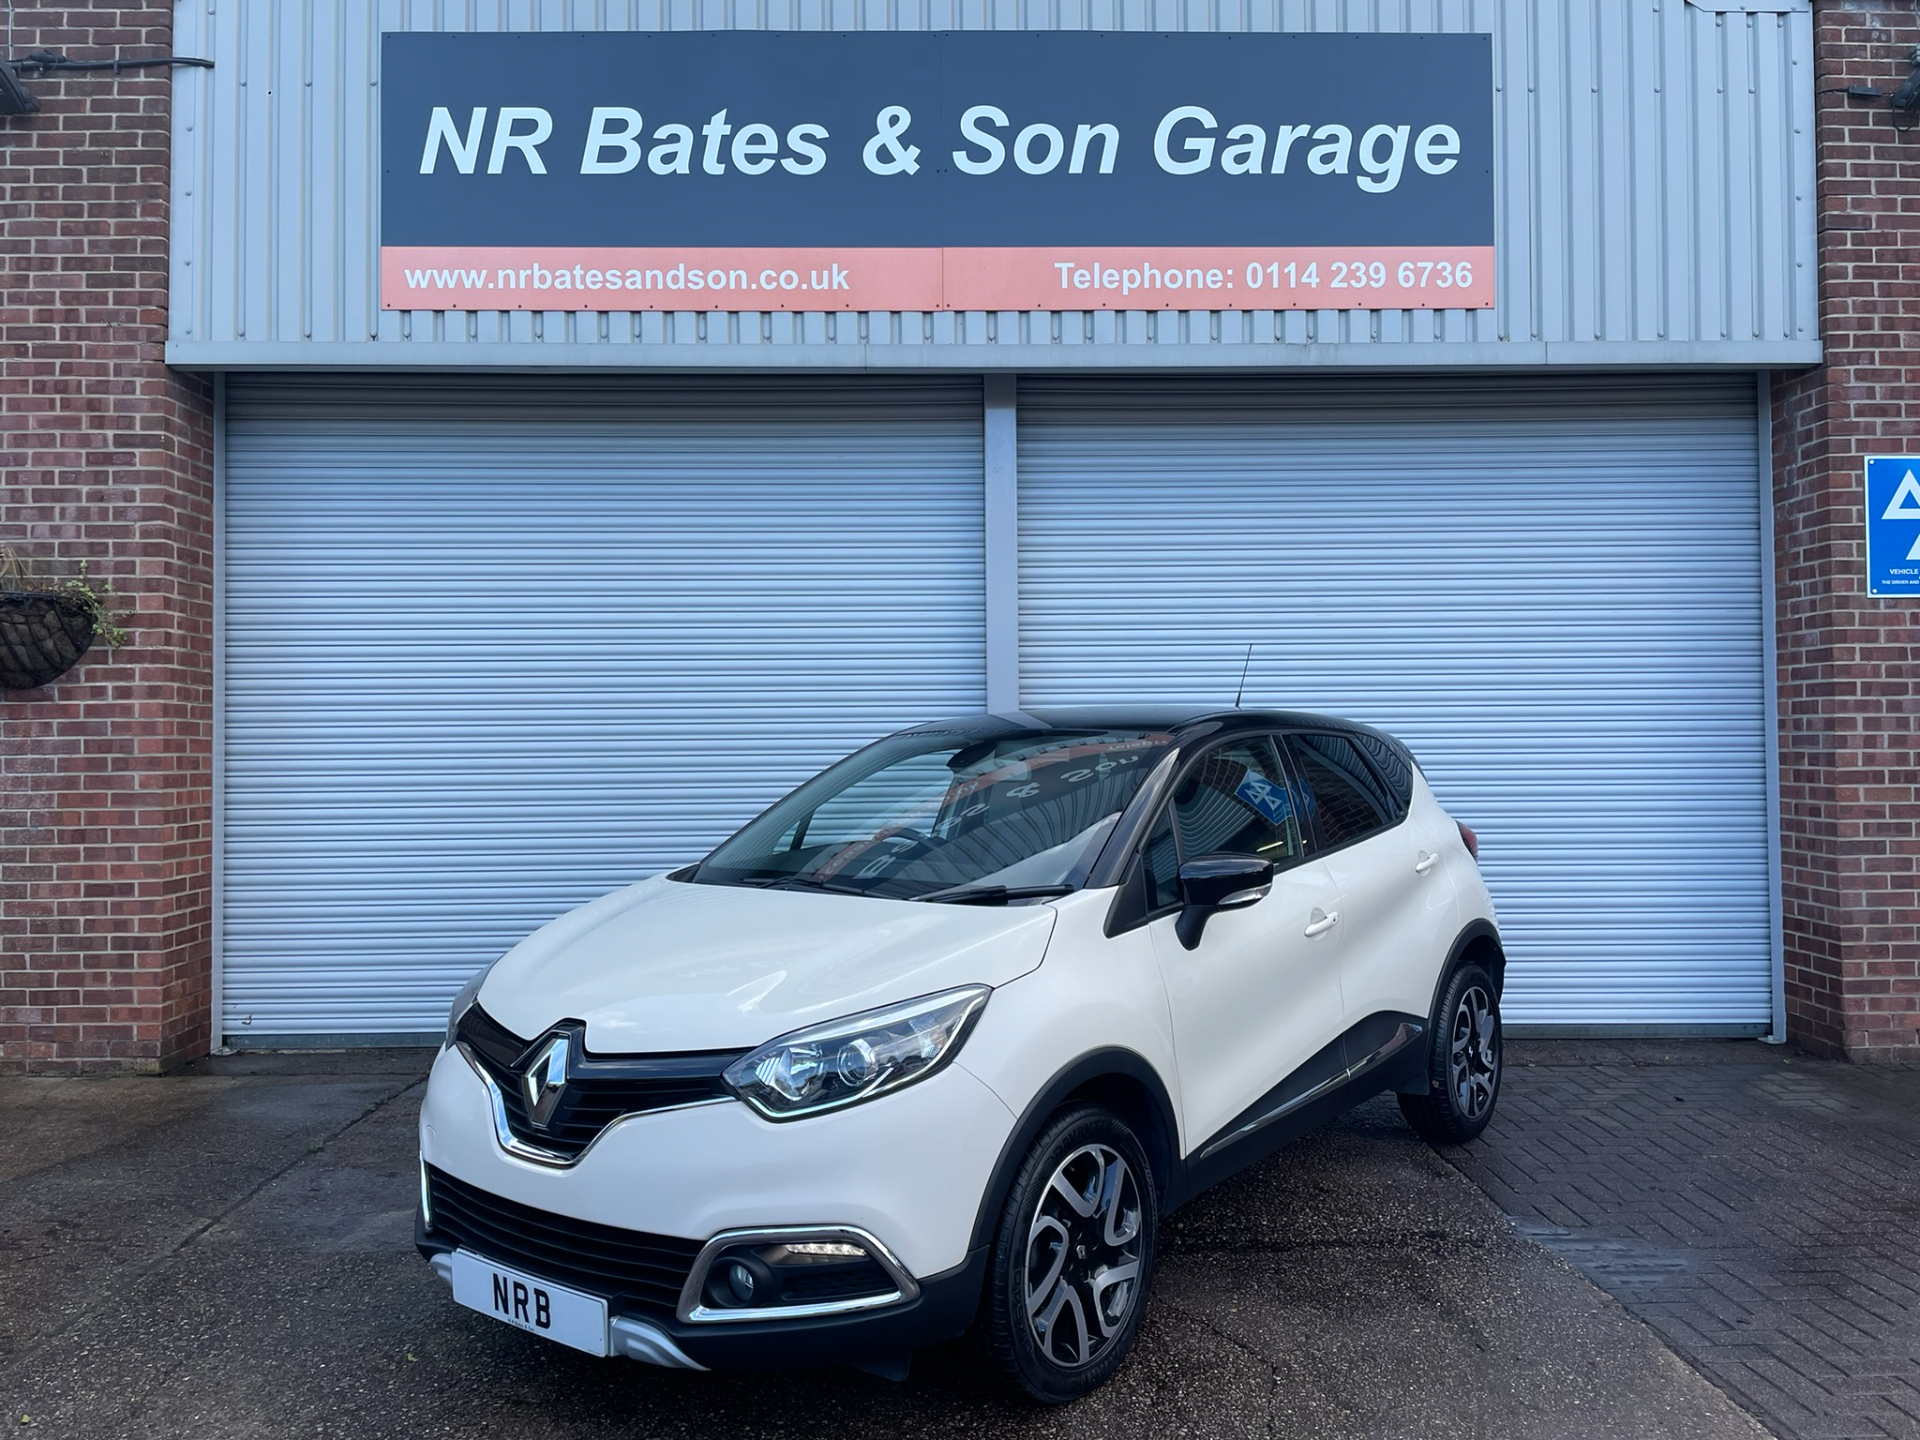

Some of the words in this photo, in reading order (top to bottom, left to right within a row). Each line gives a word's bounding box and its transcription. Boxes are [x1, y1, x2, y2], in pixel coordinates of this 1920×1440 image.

[420, 106, 553, 174] NR
[580, 106, 830, 175] Bates
[862, 105, 921, 175] &
[952, 105, 1120, 175] Son
[1153, 105, 1461, 193] Garage
[404, 262, 850, 290] www.nrbatesandson.co.uk
[1054, 262, 1234, 295] Telephone:
[1246, 261, 1320, 289] 0114
[1330, 261, 1387, 289] 239
[1397, 261, 1473, 289] 6736
[492, 1272, 551, 1330] NRB
